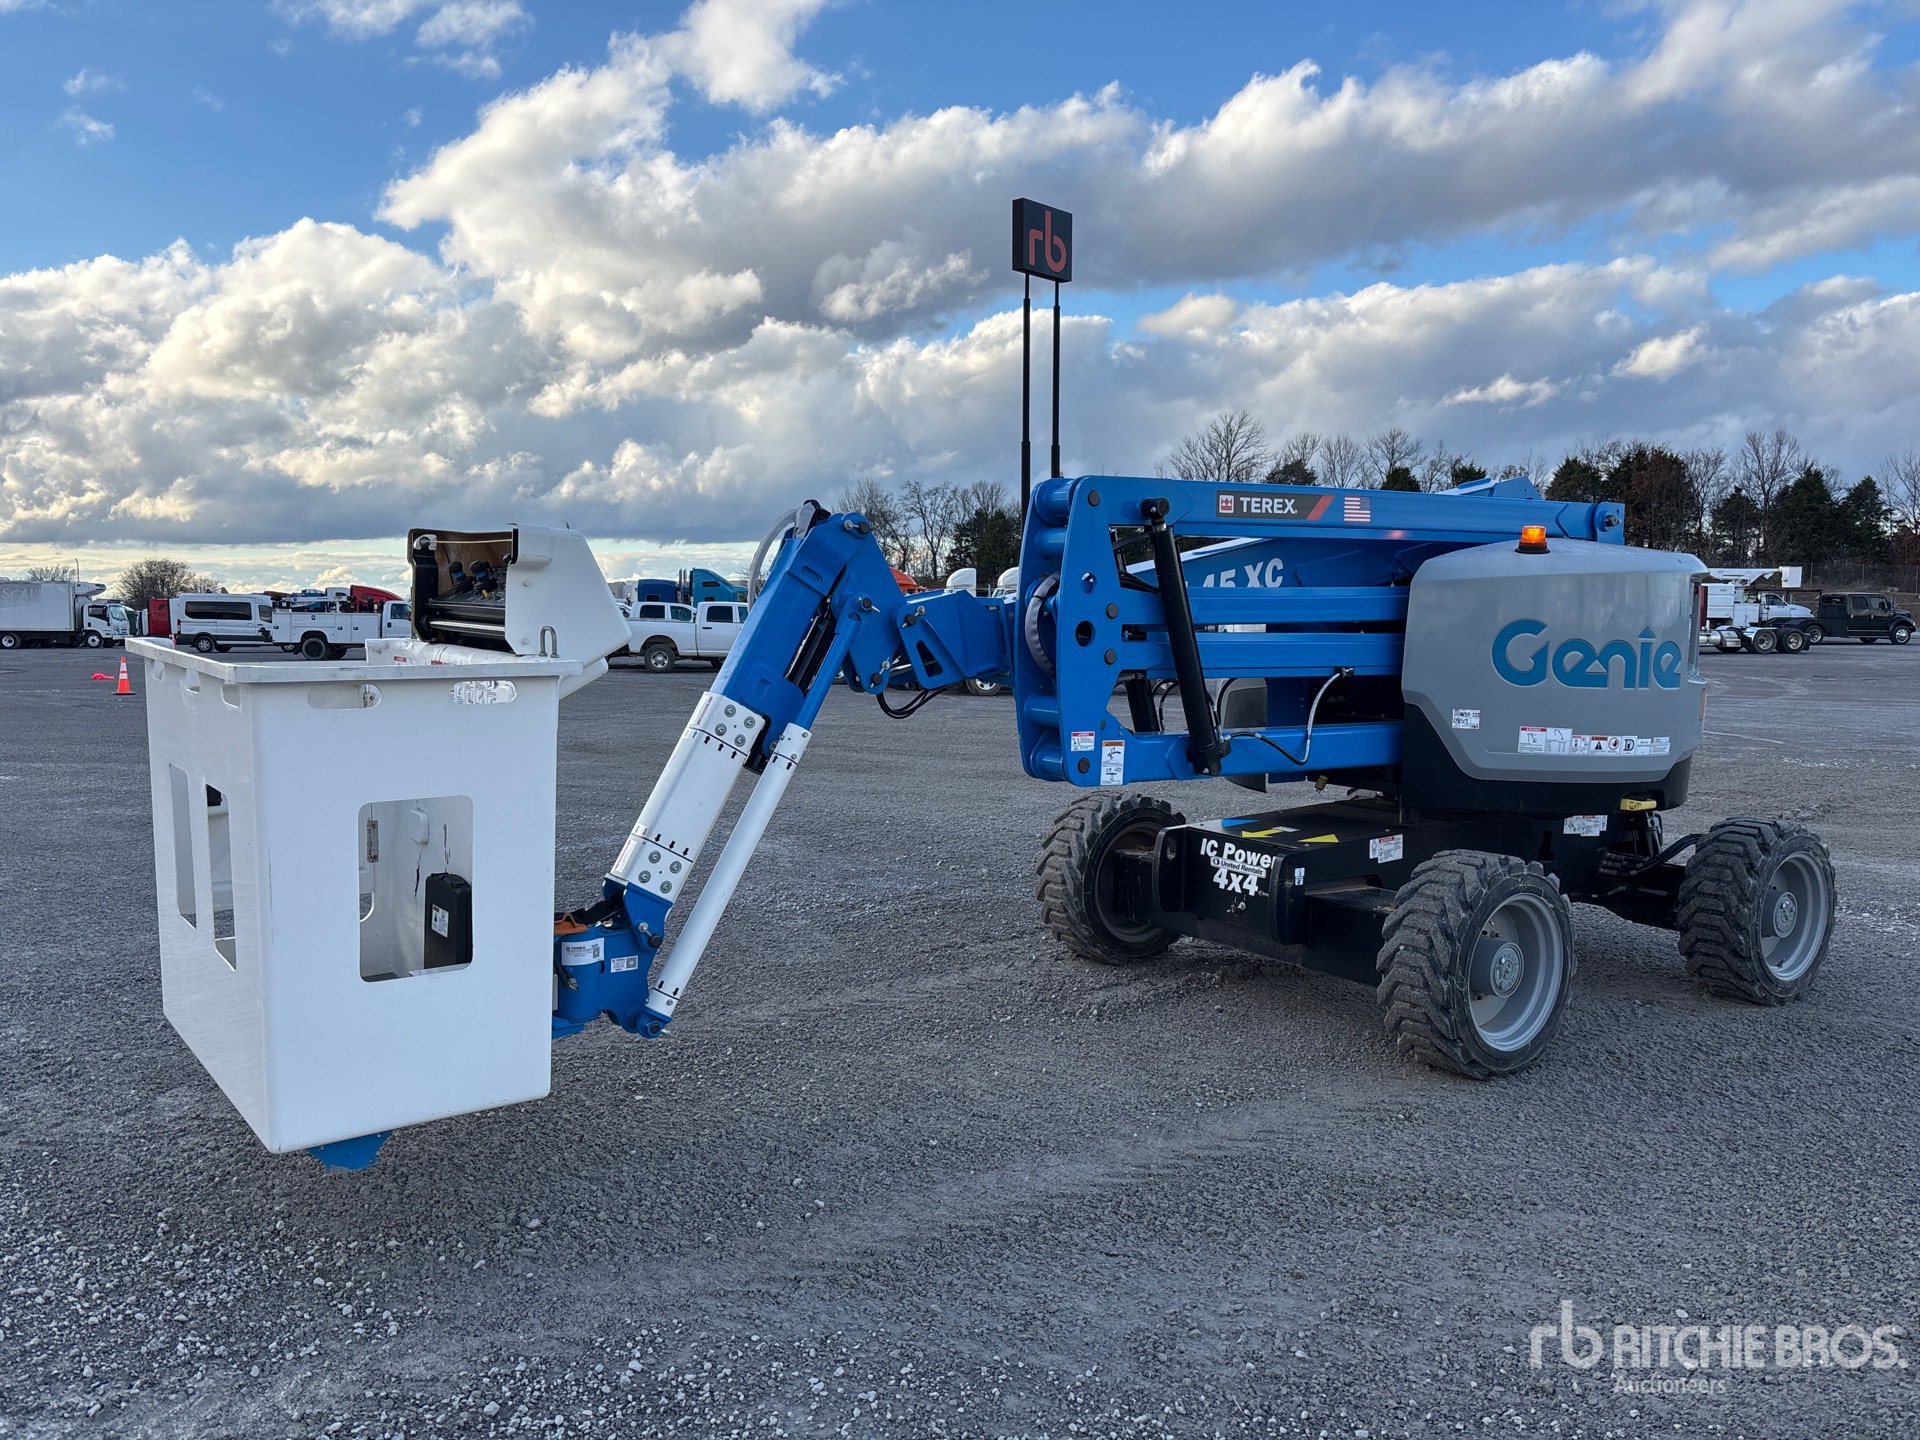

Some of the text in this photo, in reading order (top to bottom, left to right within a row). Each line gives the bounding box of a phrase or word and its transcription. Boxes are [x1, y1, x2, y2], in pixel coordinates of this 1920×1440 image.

[1029, 210, 1067, 273] rb
[1239, 497, 1296, 515] TEREX
[1243, 557, 1284, 587] XC
[1491, 617, 1683, 689] Genie
[1200, 838, 1219, 858] IC
[1213, 867, 1259, 897] 4x4
[1220, 859, 1264, 876] United Rentals
